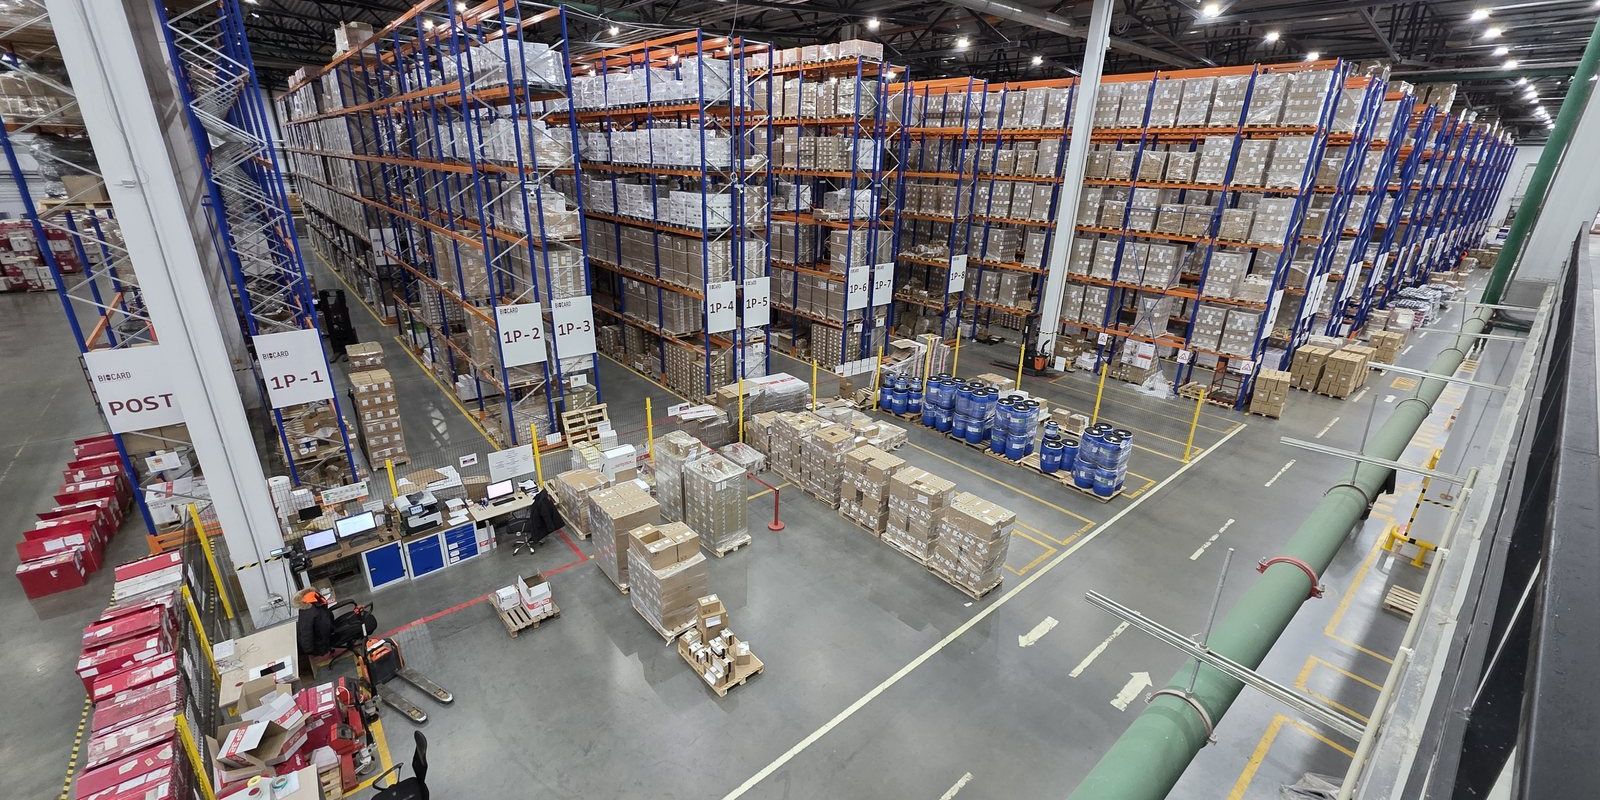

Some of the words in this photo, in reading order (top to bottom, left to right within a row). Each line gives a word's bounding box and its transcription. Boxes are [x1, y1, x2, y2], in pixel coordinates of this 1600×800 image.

[950, 270, 966, 281] 1P-8
[849, 283, 867, 294] 1P-6
[875, 279, 892, 290] 1P-7
[709, 300, 735, 314] 1P-4
[746, 296, 769, 309] 1P-5
[558, 320, 592, 336] 1P-3
[503, 327, 541, 344] 1P-2
[270, 370, 324, 391] 1P-1
[108, 393, 173, 416] POST
